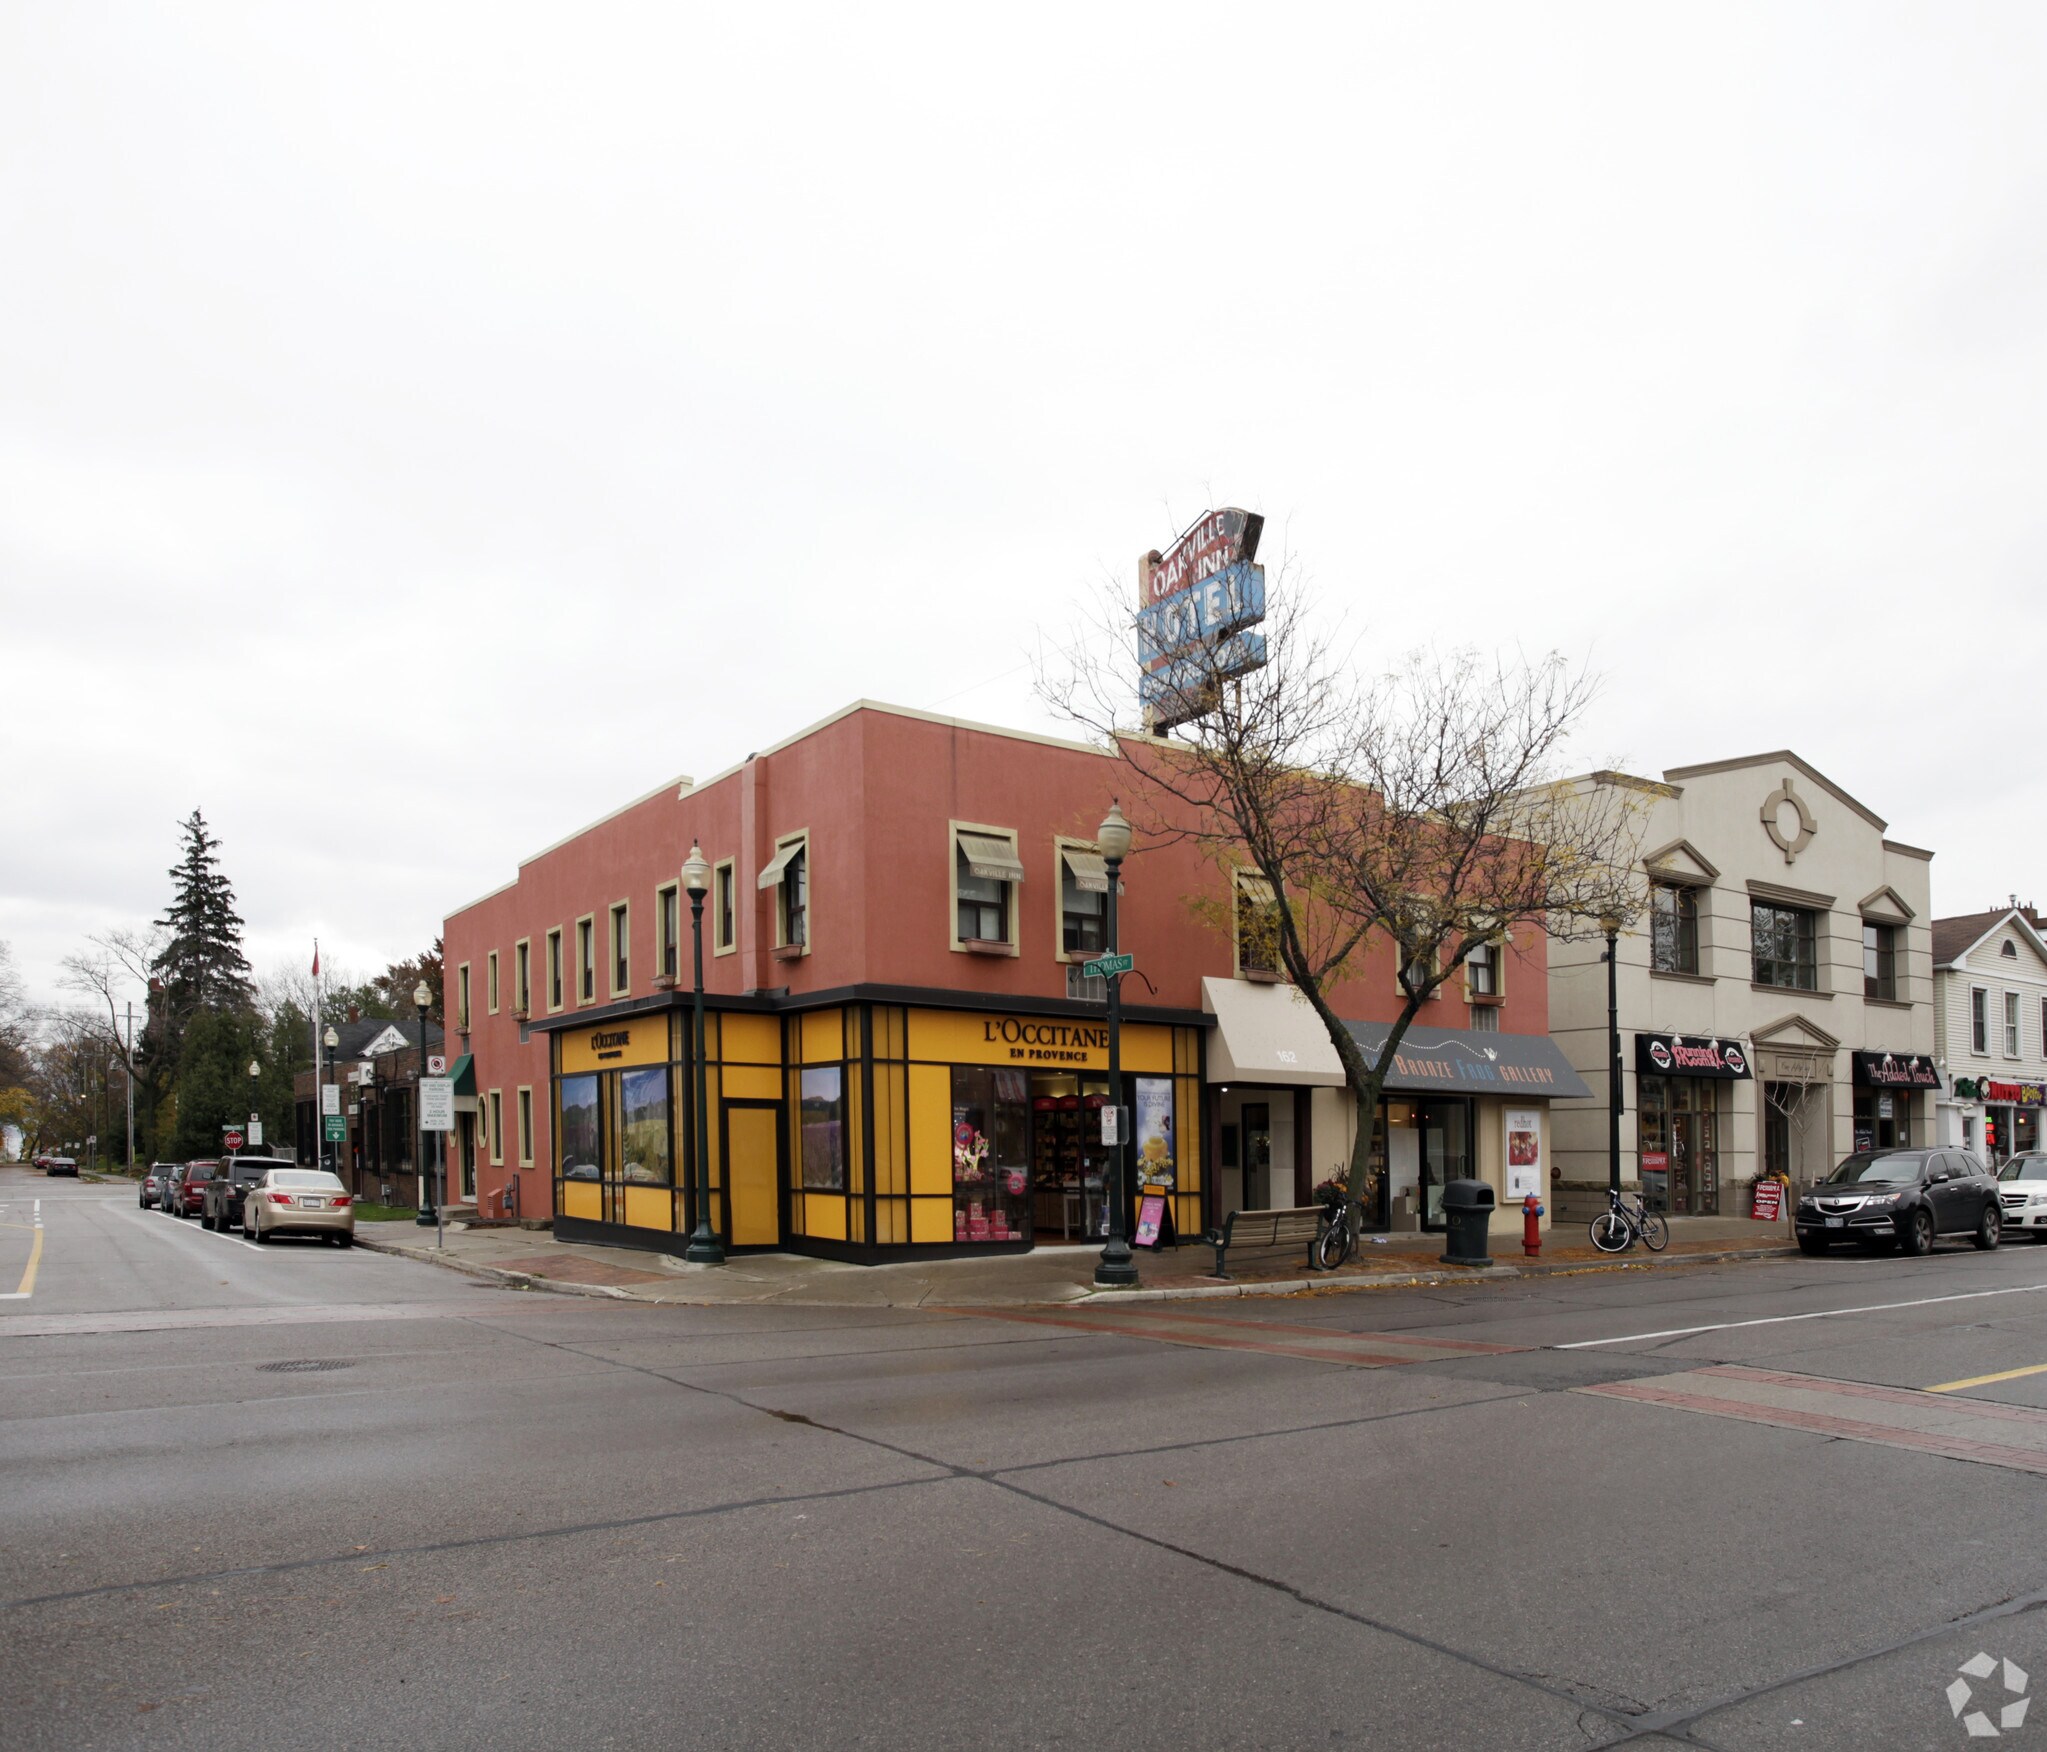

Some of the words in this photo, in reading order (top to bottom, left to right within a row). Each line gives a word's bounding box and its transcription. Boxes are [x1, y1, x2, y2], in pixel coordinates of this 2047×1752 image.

[1153, 514, 1225, 597] OAKVILLE
[1198, 546, 1229, 580] INN
[974, 867, 1007, 879] OAKVILLE
[1008, 871, 1021, 880] INN
[1079, 880, 1108, 891] OAKVILL
[1090, 959, 1122, 973] THOMAS
[1010, 1048, 1024, 1060] EN
[1029, 1049, 1088, 1062] PROVENCE
[1276, 1050, 1298, 1063] 162
[1456, 1058, 1495, 1081] FROG
[1868, 1062, 1881, 1078] The
[1881, 1061, 1910, 1083] Added
[1909, 1065, 1936, 1084] Touch
